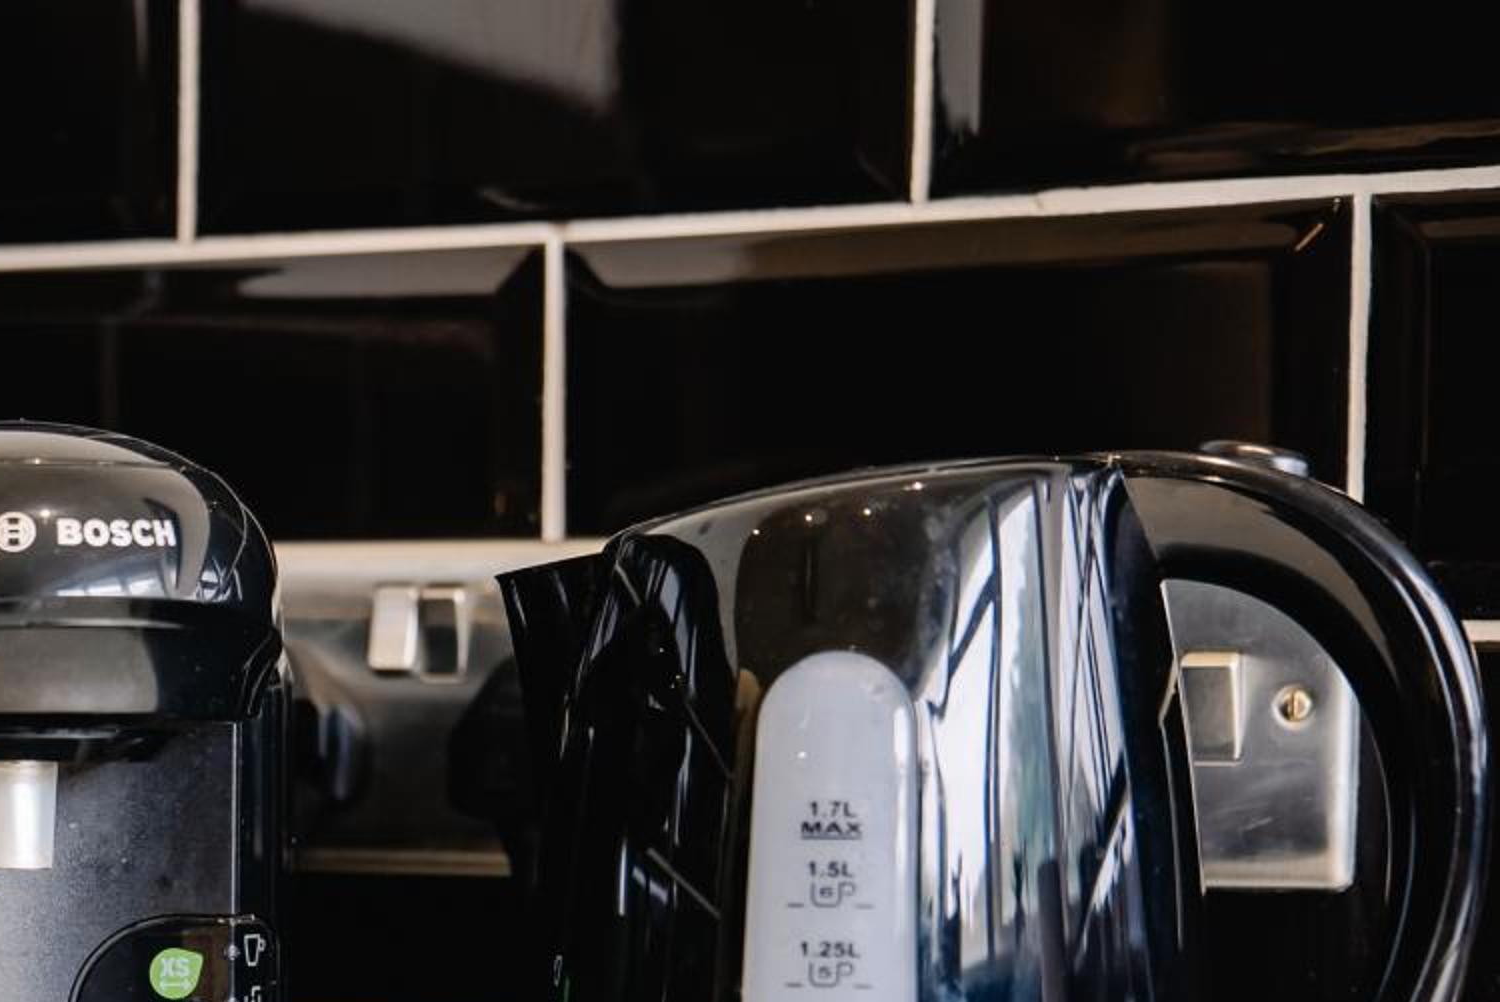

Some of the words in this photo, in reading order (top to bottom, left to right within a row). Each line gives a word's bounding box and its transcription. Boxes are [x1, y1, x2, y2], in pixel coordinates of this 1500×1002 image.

[56, 518, 177, 547] BOSCH
[801, 821, 861, 834] MAX
[159, 957, 191, 977] XS
